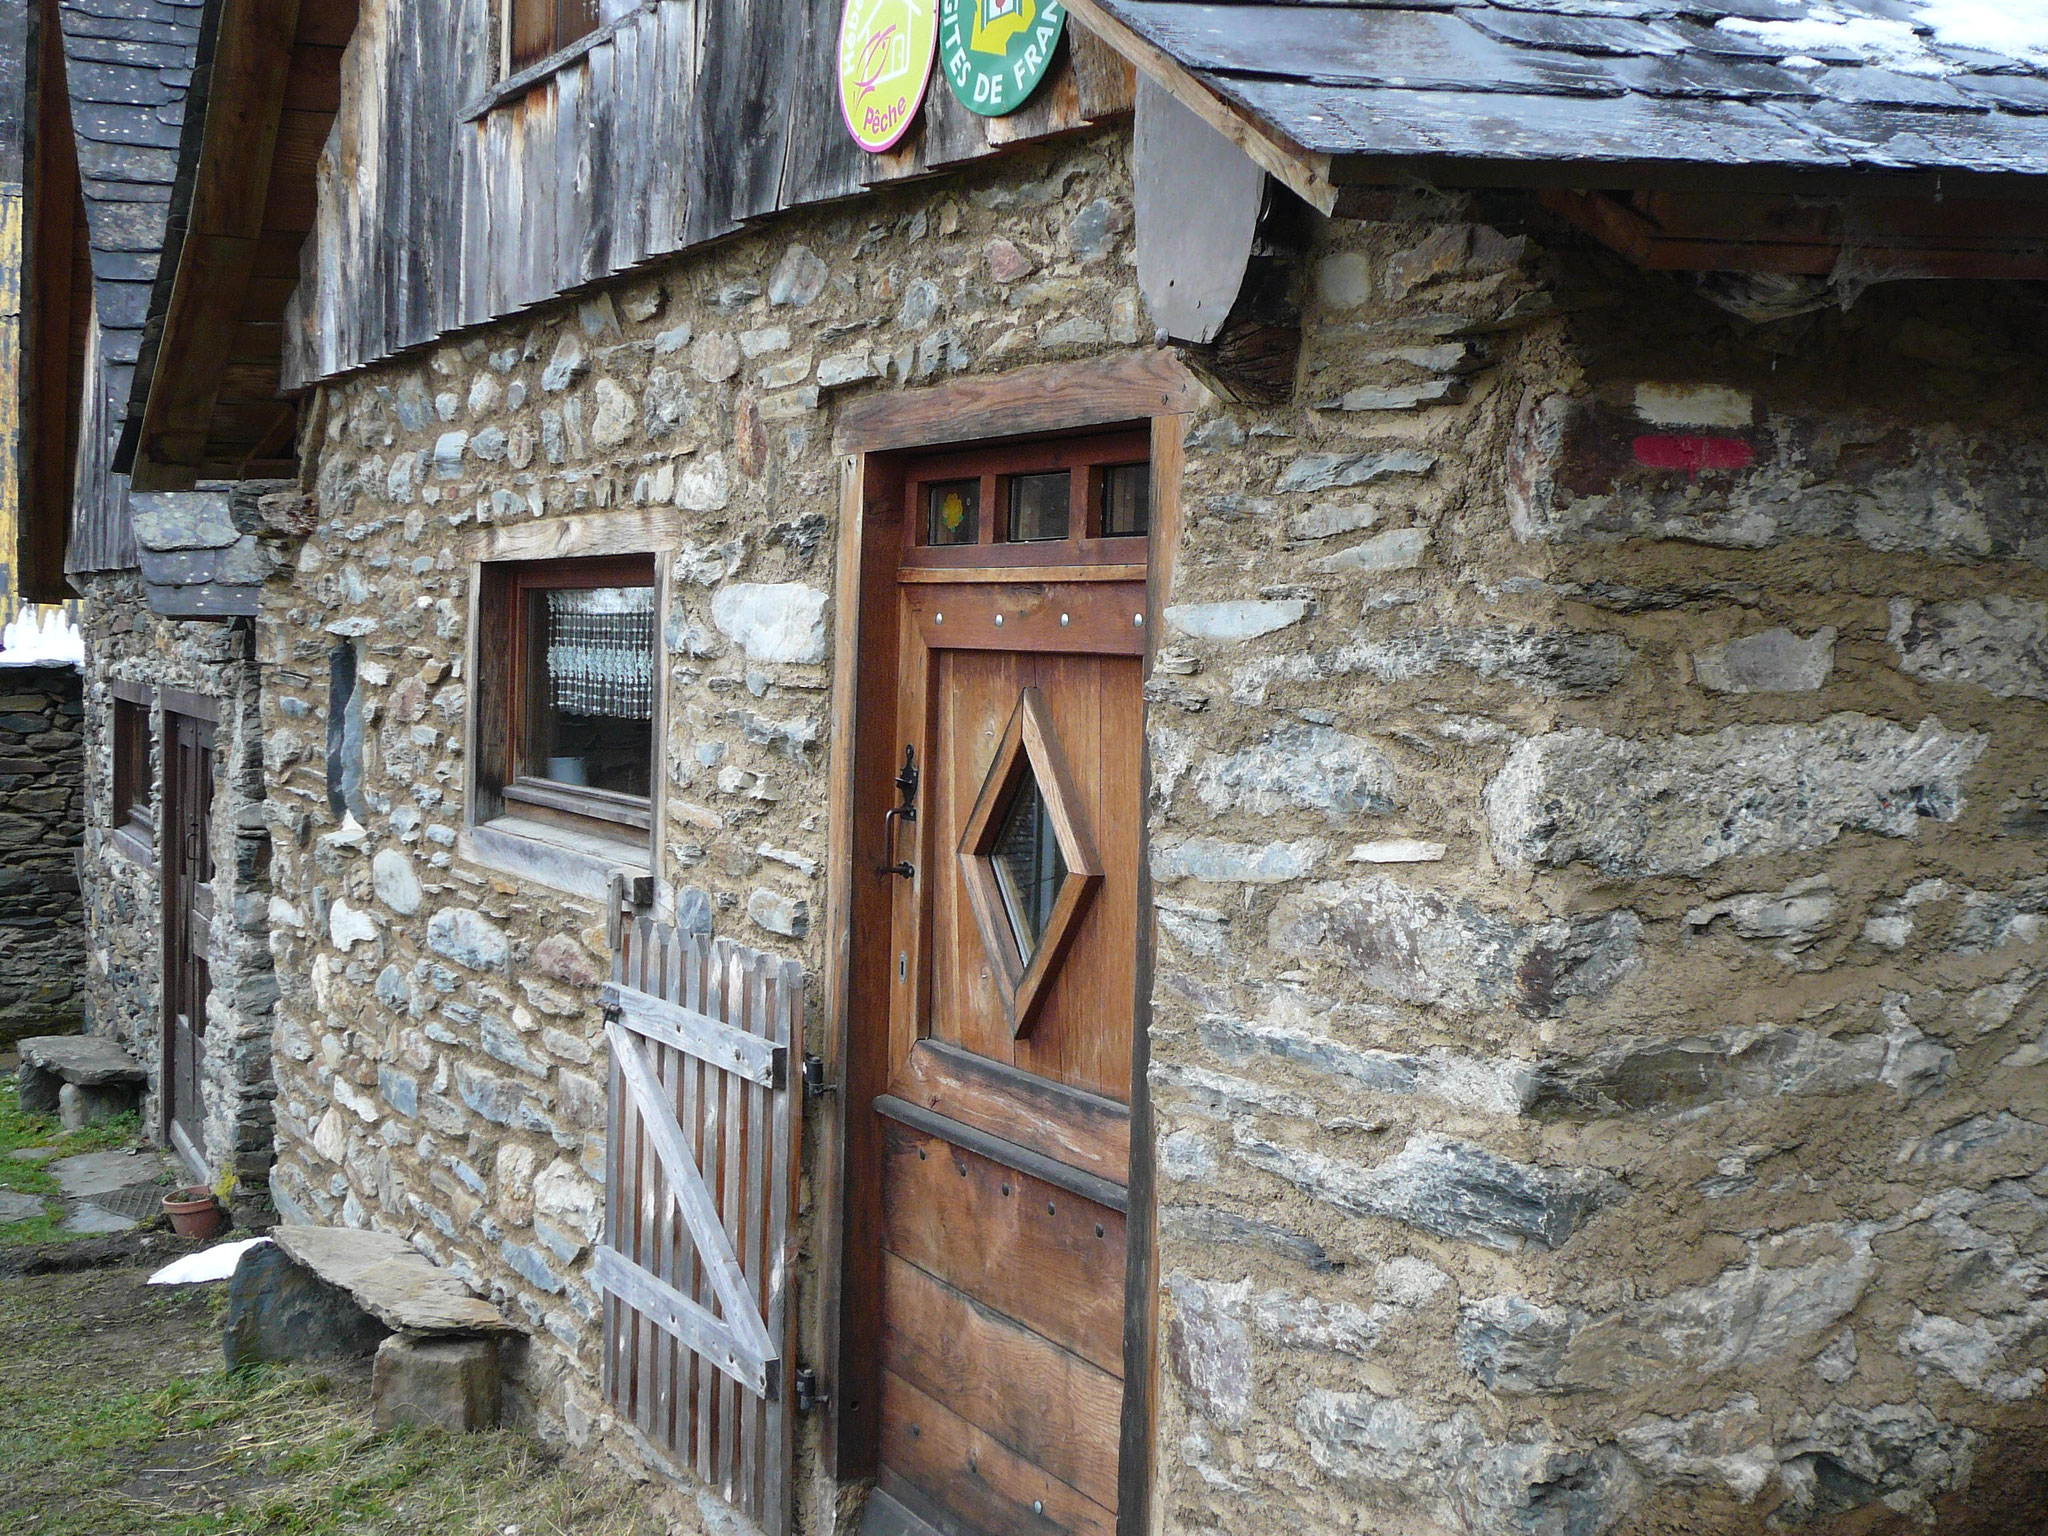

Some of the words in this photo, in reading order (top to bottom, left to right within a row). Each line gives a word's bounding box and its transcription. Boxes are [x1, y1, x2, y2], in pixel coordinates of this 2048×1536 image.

[944, 0, 972, 88] GITES
[973, 72, 1003, 105] DE
[863, 96, 907, 135] Pêche
